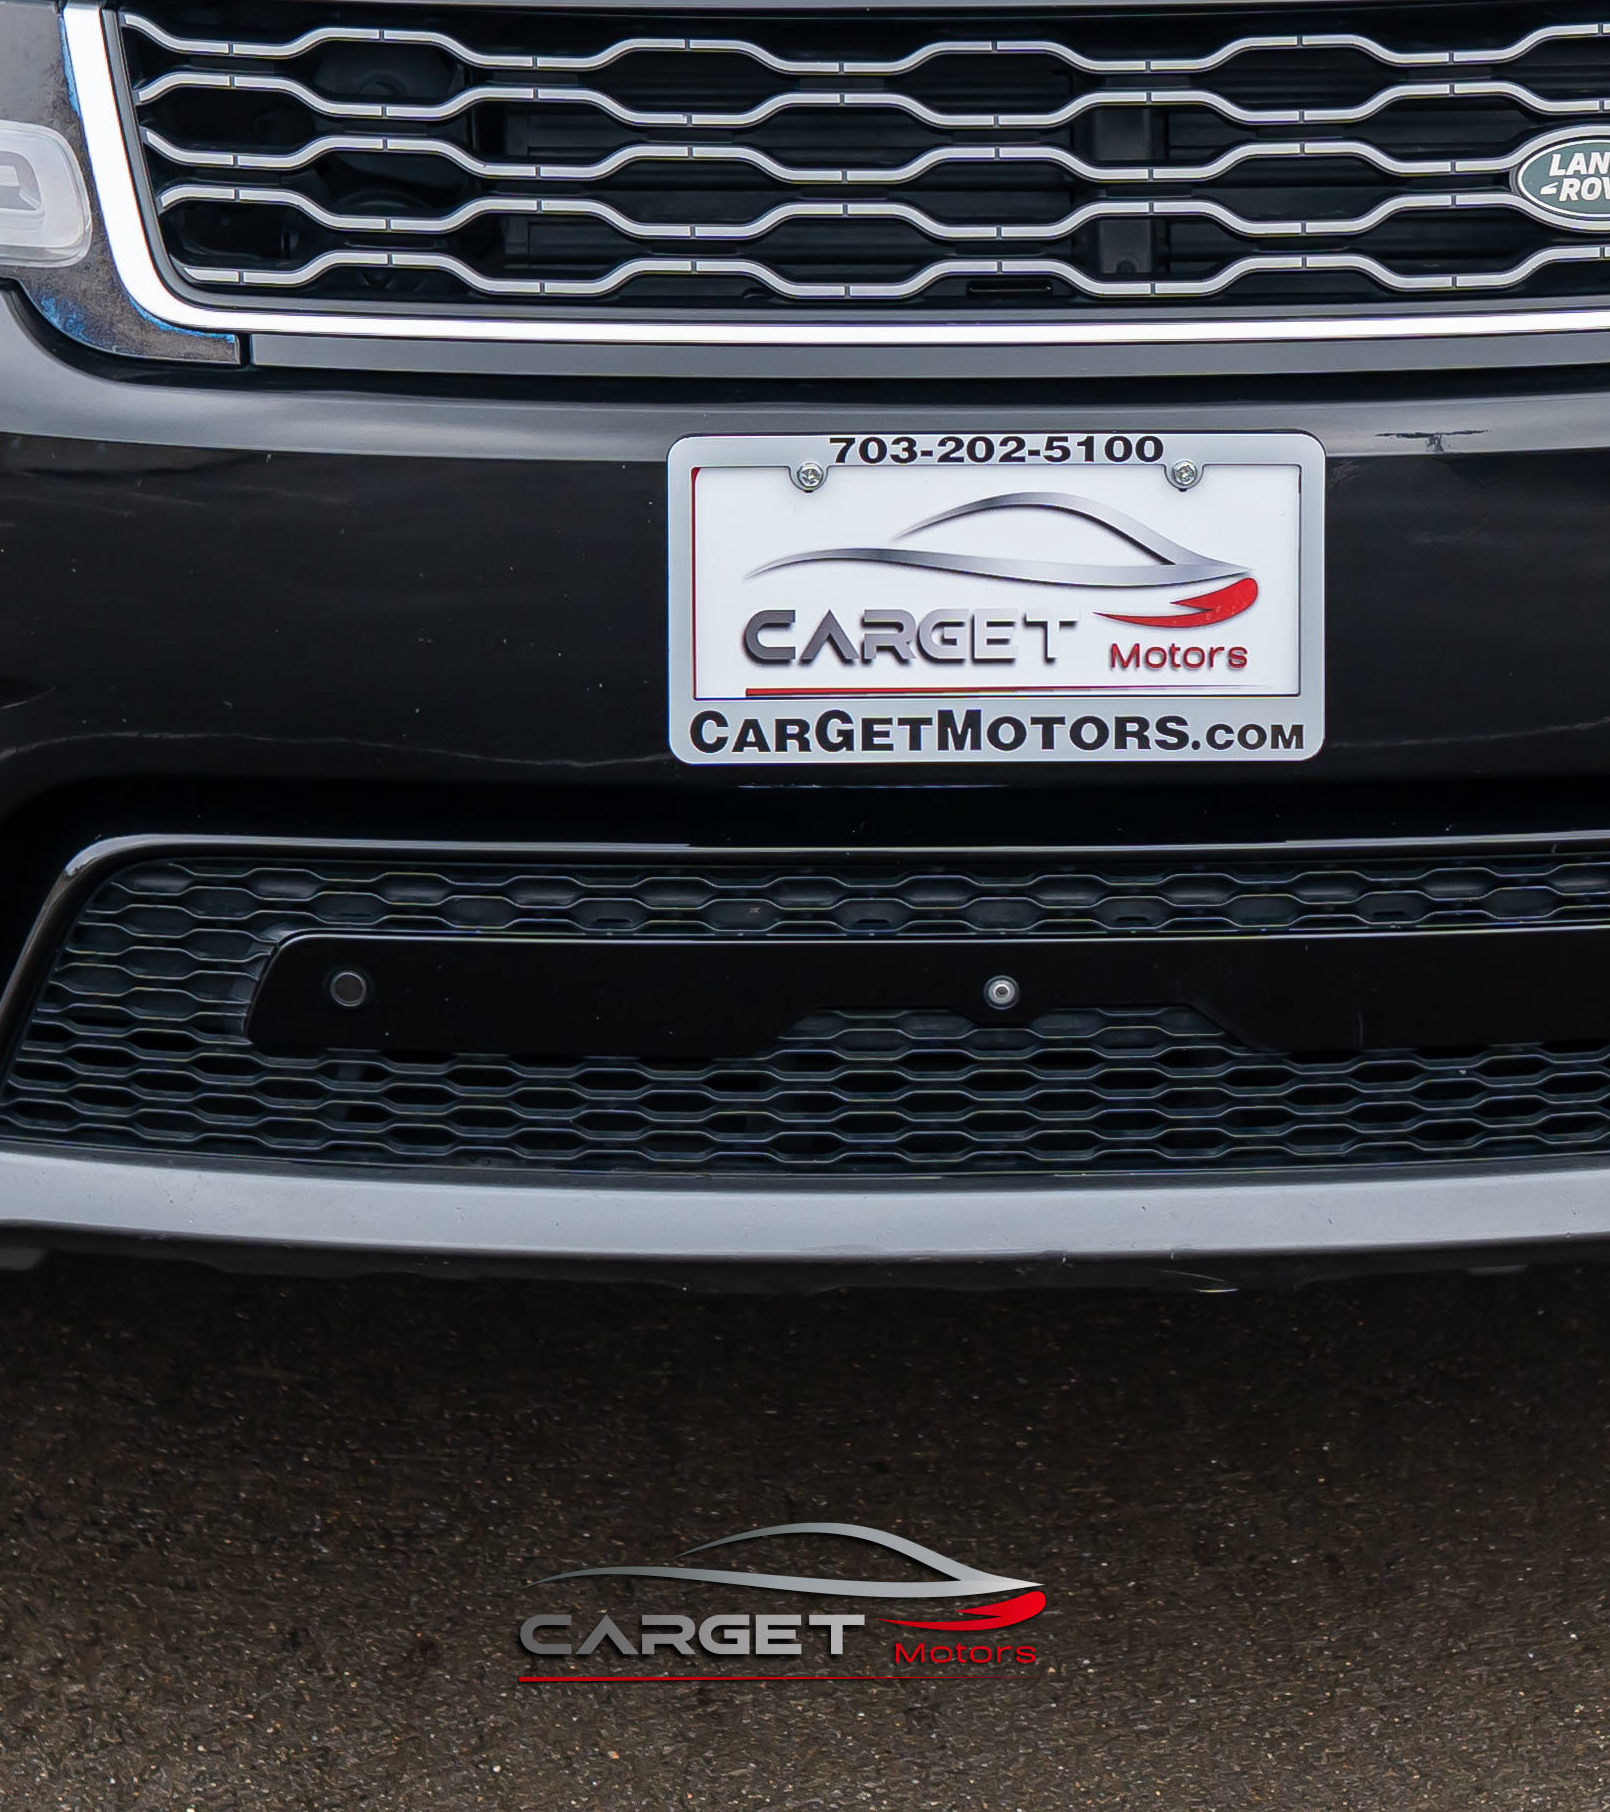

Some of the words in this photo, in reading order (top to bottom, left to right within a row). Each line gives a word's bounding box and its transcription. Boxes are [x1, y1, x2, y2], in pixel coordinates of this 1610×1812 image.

[829, 436, 1165, 465] 703-202-5100
[743, 608, 1079, 664] CARGET
[1109, 642, 1250, 670] Motors
